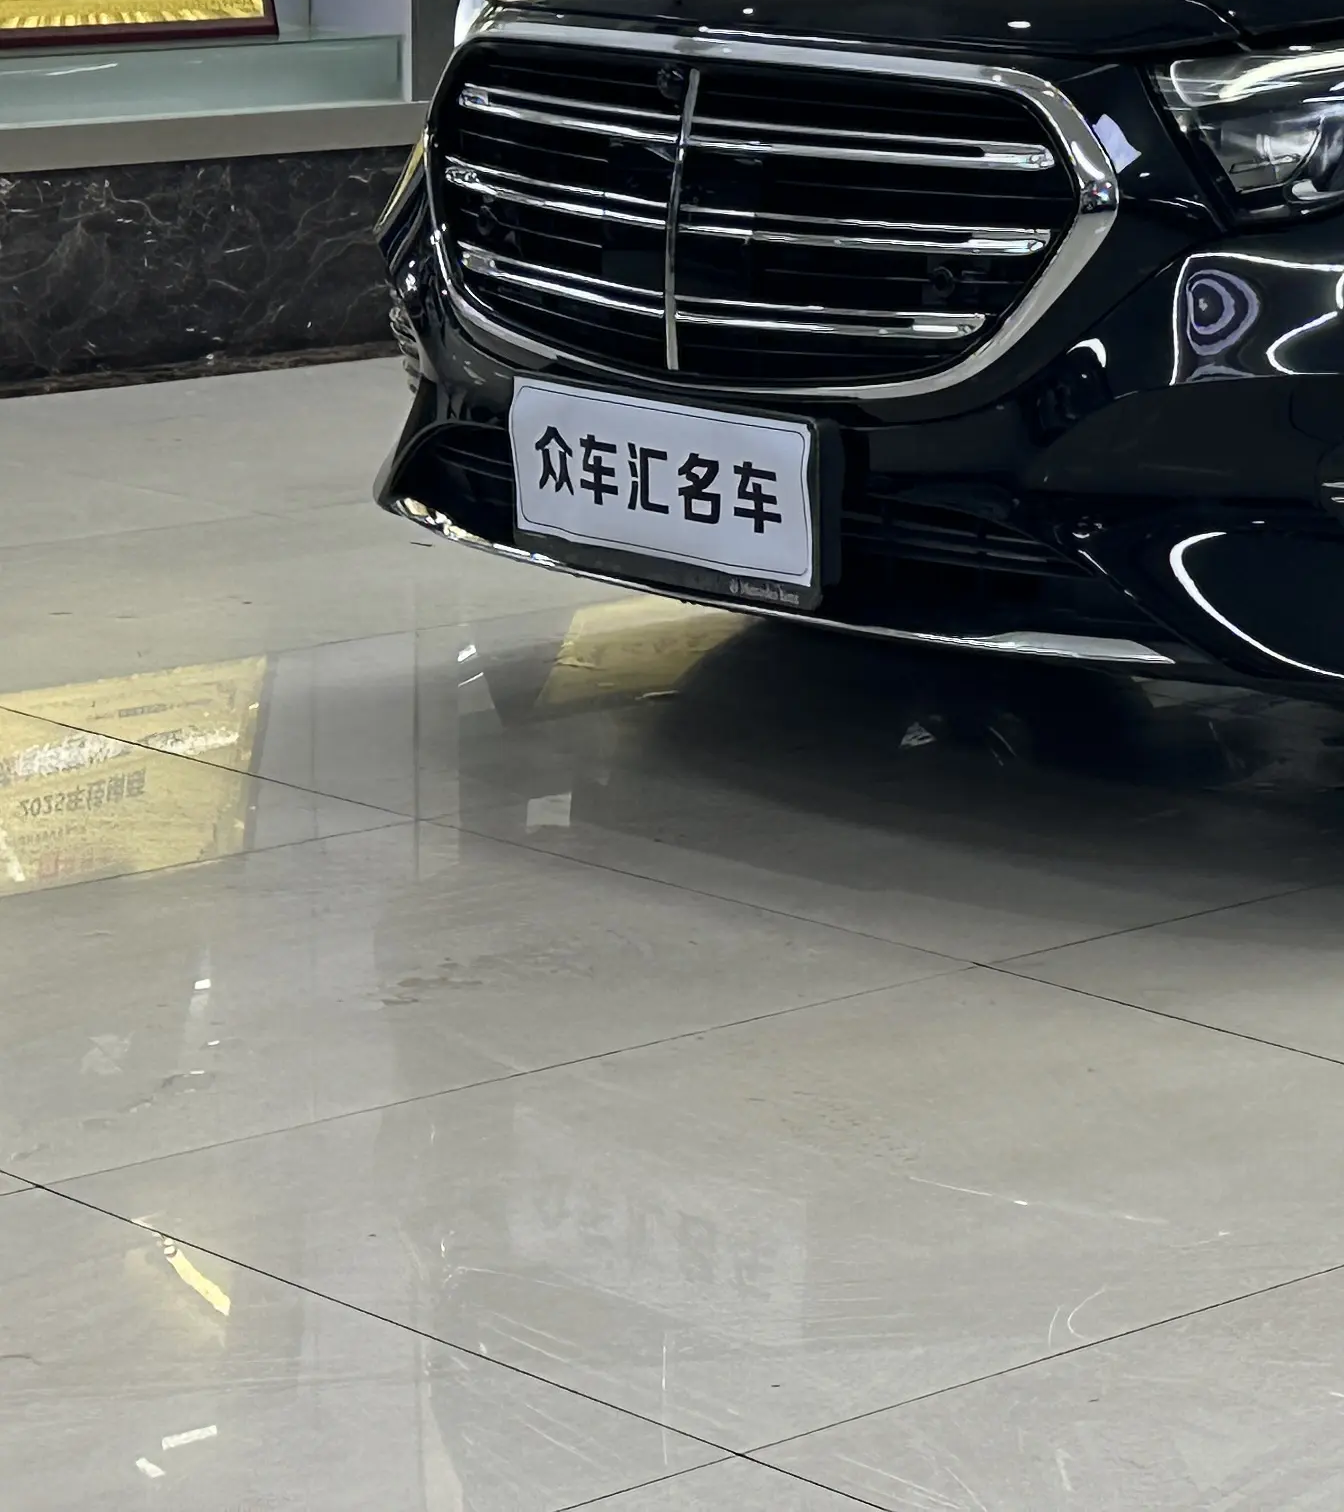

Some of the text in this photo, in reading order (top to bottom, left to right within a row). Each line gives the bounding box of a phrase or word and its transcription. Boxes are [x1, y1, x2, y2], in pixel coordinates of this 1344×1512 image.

[534, 425, 783, 534] 众车汇名车
